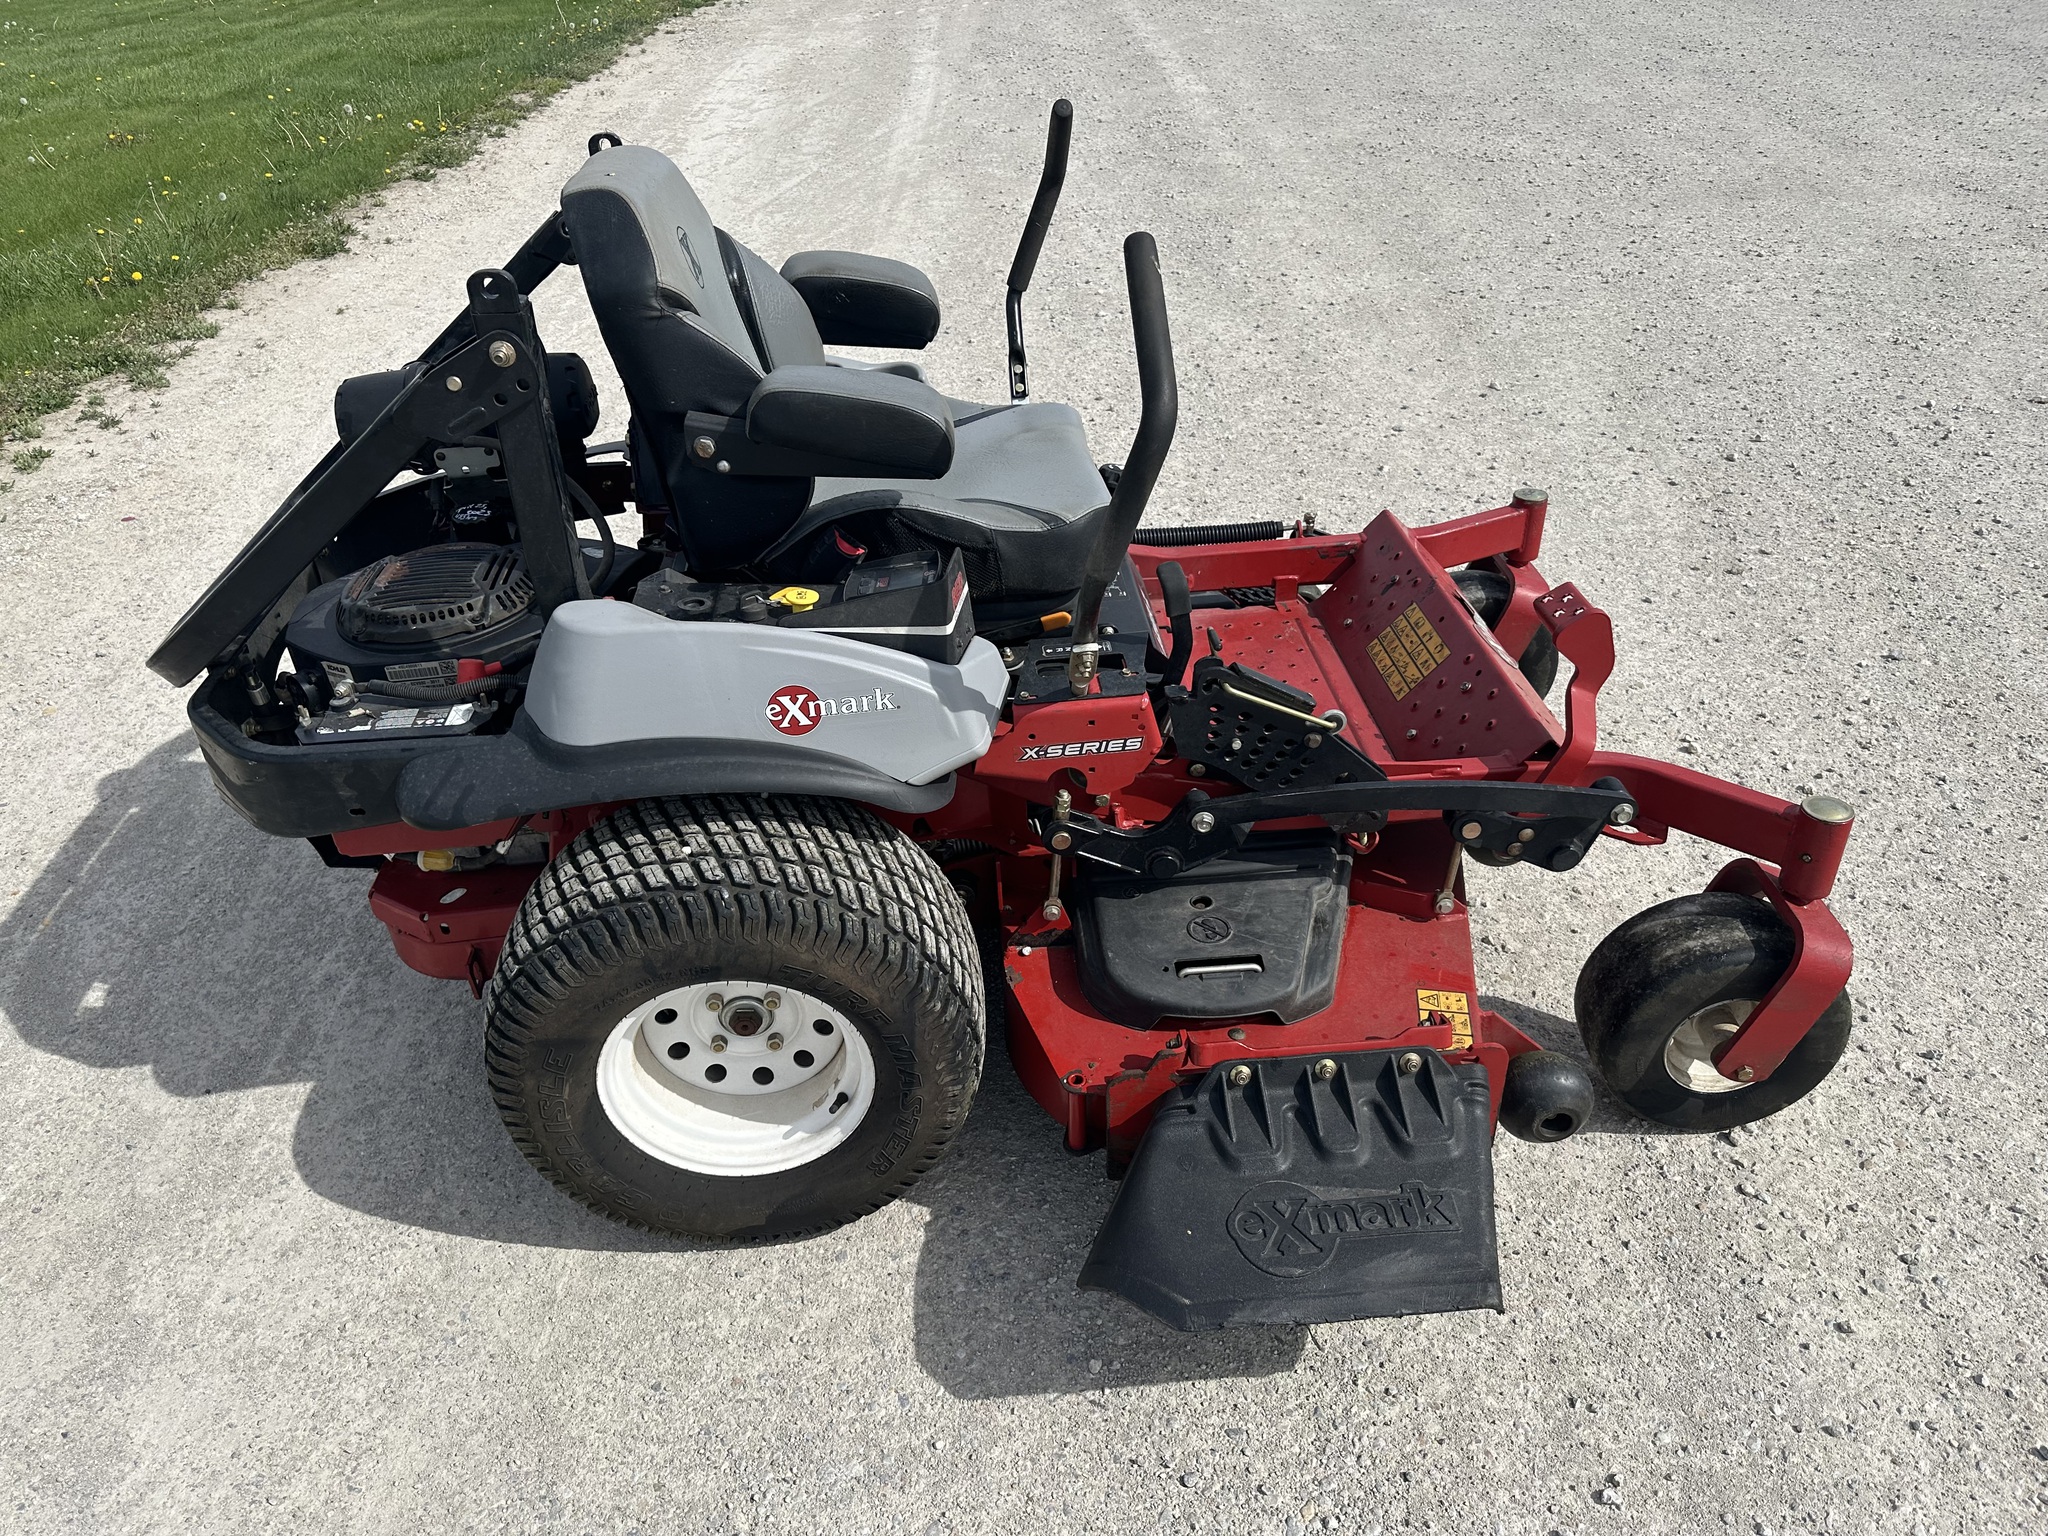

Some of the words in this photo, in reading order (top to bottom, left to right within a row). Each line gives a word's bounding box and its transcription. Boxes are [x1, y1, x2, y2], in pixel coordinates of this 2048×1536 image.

[765, 687, 896, 729] eXmark
[1021, 736, 1143, 760] X-SERIES
[778, 963, 894, 1025] TURF
[866, 1033, 924, 1178] MASTER
[538, 1048, 653, 1210] CARLISLE
[1234, 1187, 1453, 1258] eXmark
